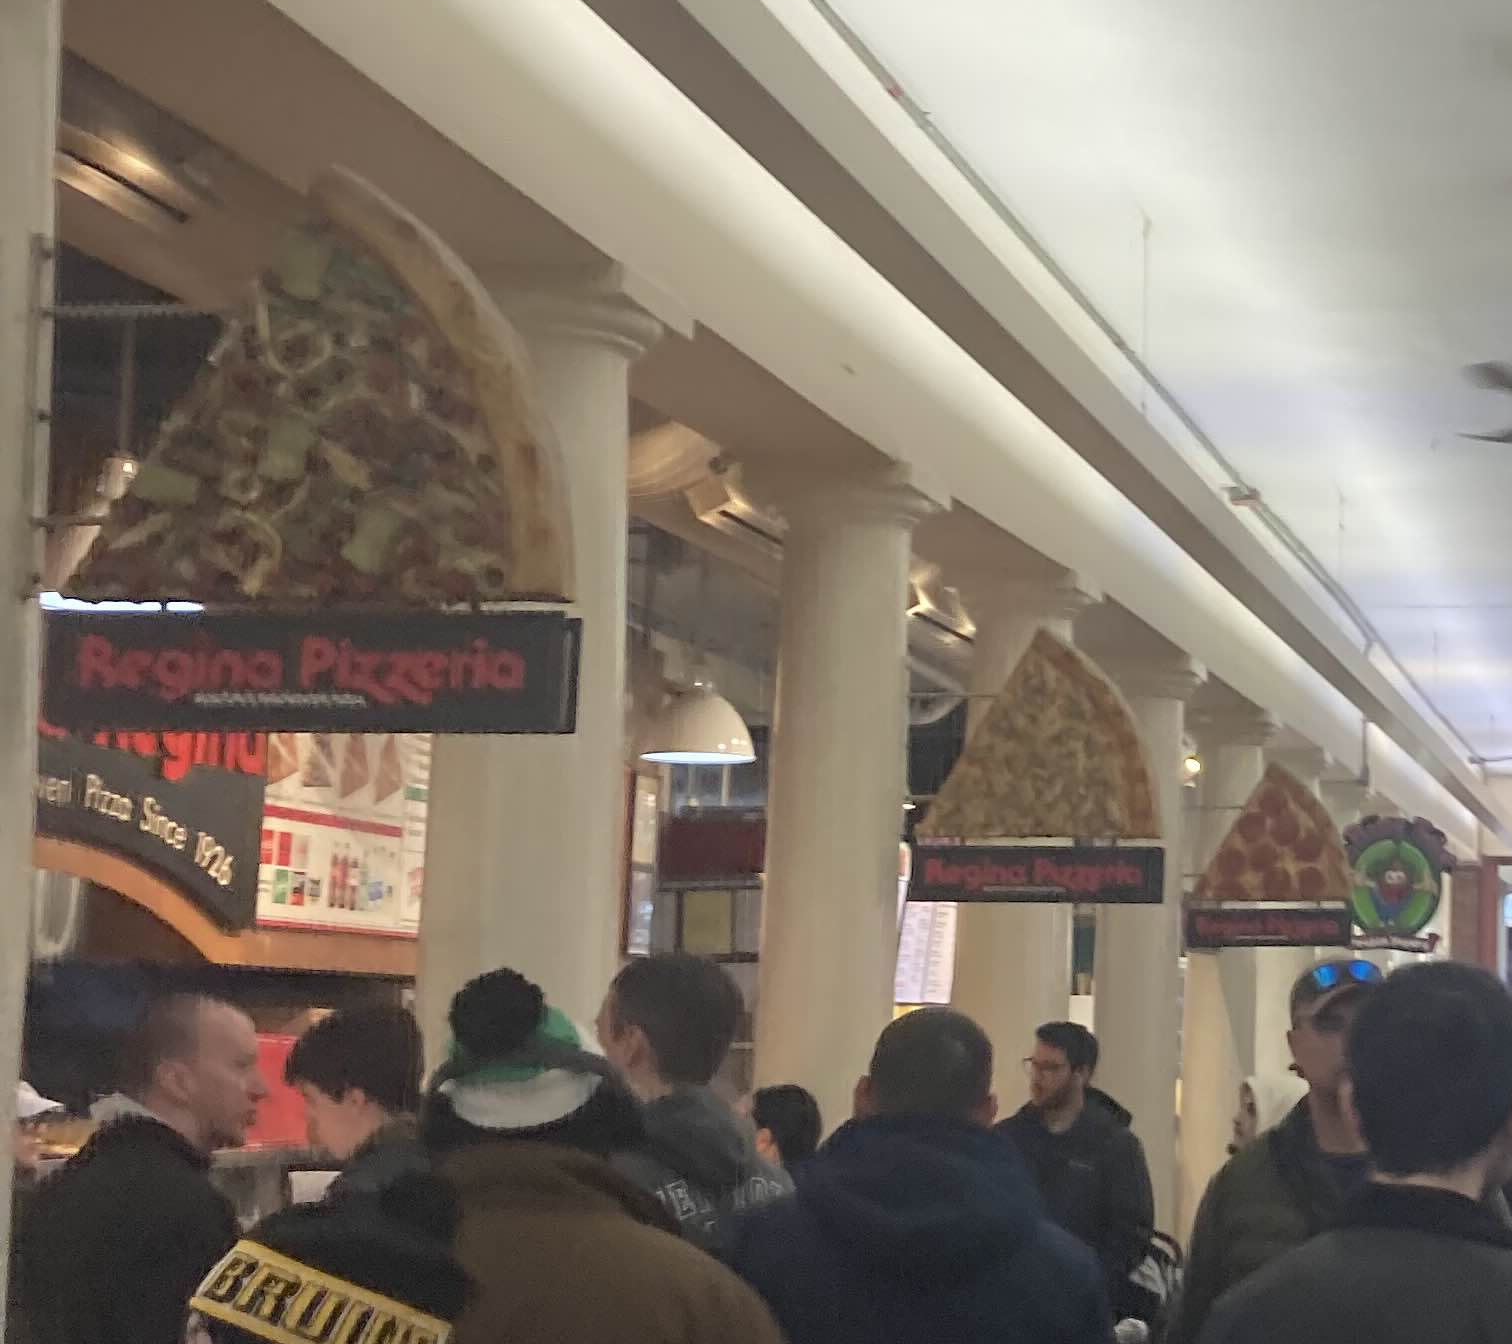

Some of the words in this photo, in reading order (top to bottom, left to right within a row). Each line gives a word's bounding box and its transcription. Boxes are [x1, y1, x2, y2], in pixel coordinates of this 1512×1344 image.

[79, 633, 284, 701] Regina
[301, 634, 526, 704] Pizzeria
[84, 773, 133, 822] Pizza
[139, 796, 188, 851] Since
